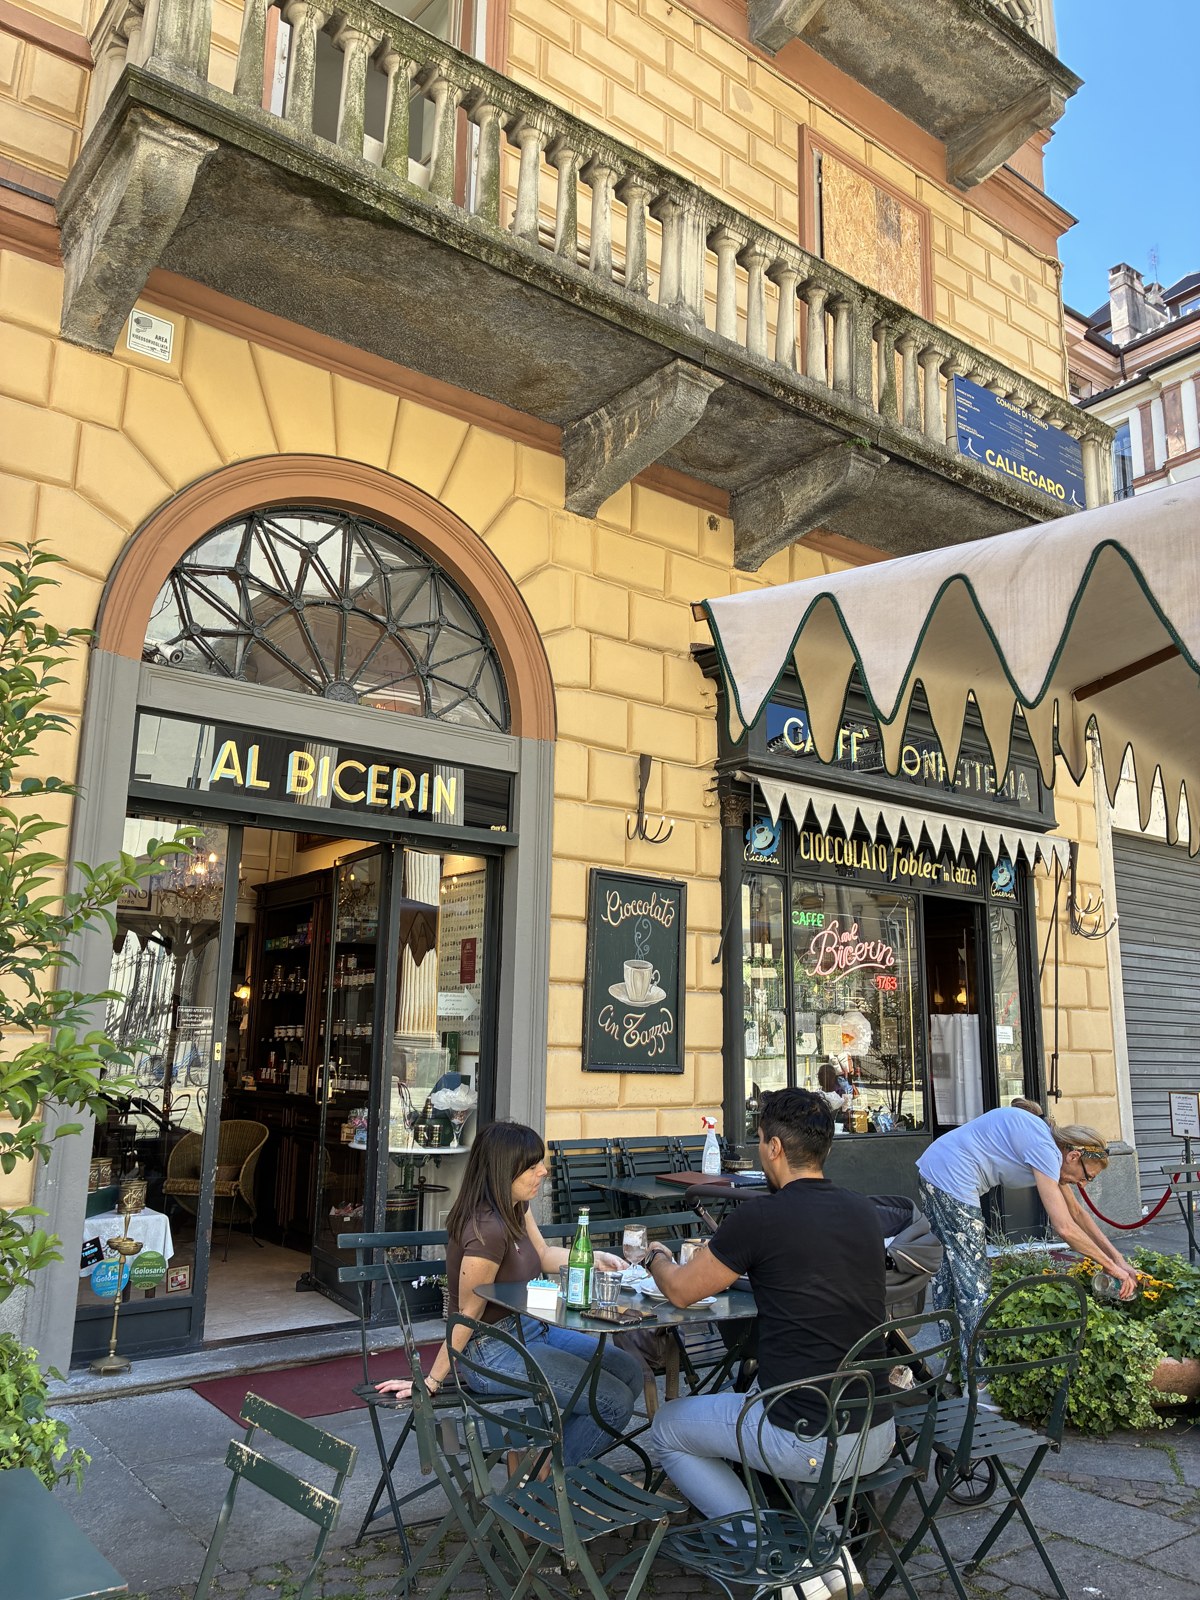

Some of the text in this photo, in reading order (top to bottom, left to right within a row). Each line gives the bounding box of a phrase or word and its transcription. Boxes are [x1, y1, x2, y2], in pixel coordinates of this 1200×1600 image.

[155, 334, 168, 343] AREA
[995, 396, 1021, 416] COMUNE
[1021, 410, 1029, 420] DI
[1028, 413, 1049, 431] TORINO
[985, 449, 1065, 500] CALLEGARO
[208, 740, 457, 816] AL BICERIN
[800, 831, 977, 886] CIOCCOLATO Tobler in tazza
[601, 889, 675, 928] Cioccolato
[804, 919, 895, 977] Bicerin
[875, 975, 898, 991] 1763
[598, 1004, 674, 1057] in Tazza
[134, 1266, 166, 1276] Golosario
